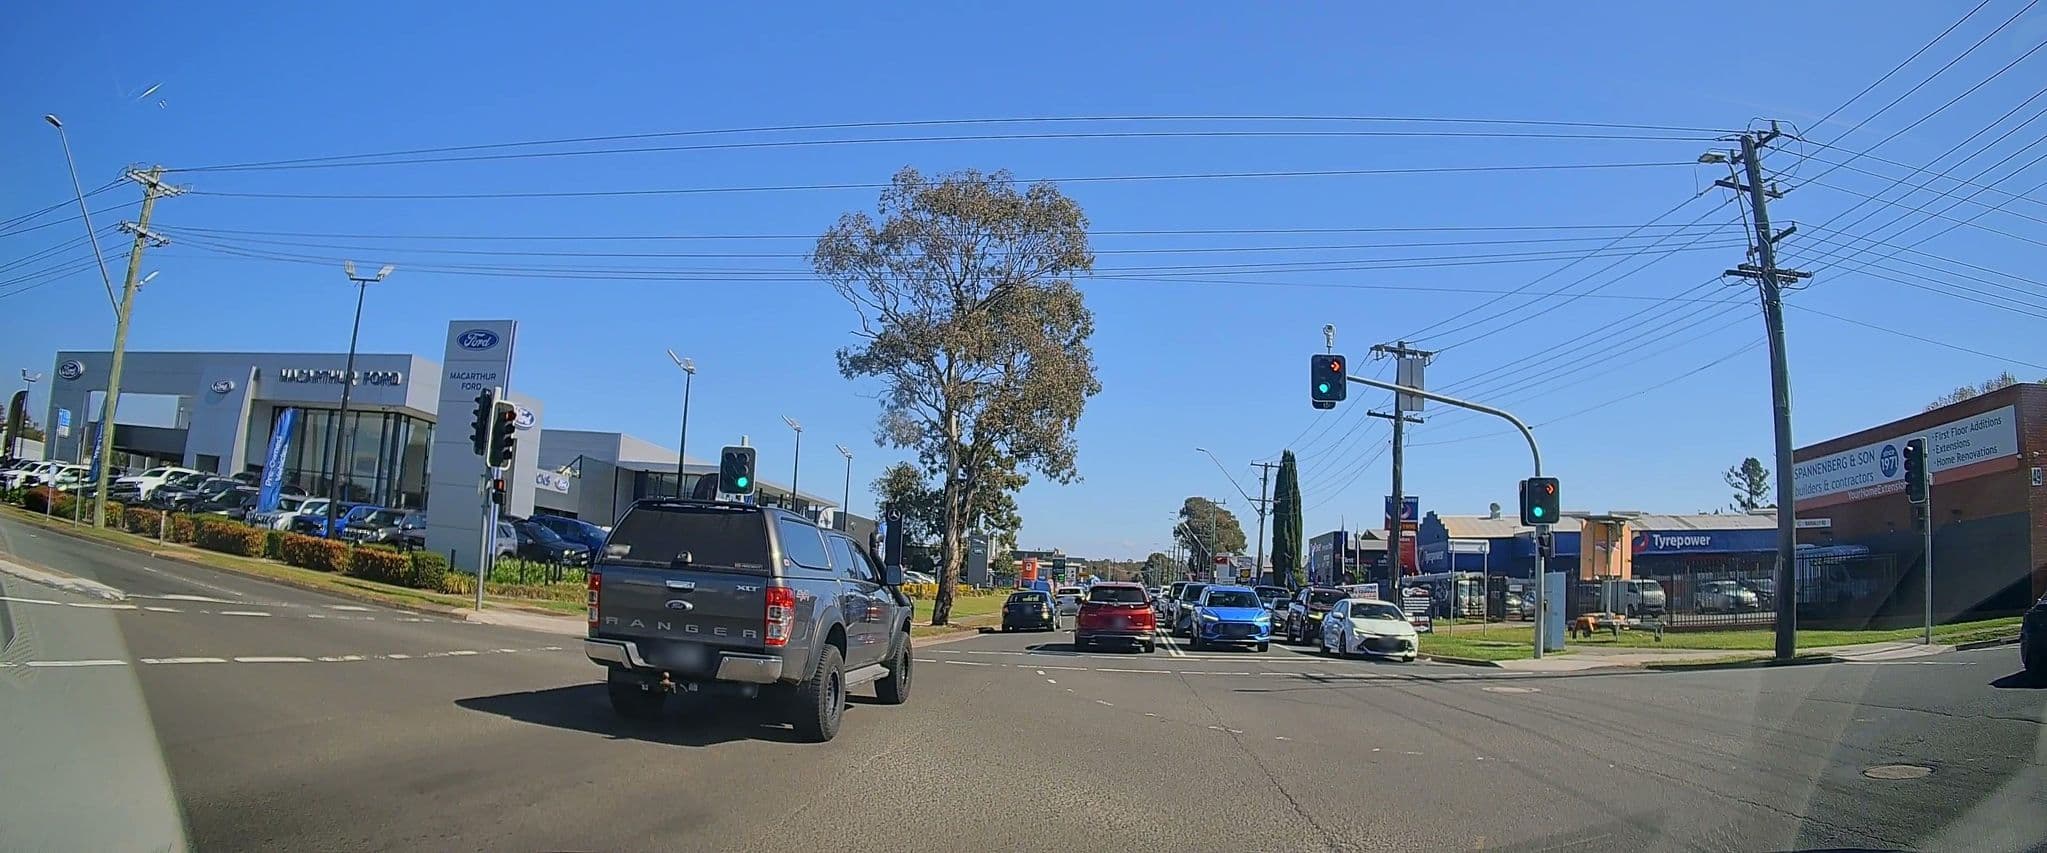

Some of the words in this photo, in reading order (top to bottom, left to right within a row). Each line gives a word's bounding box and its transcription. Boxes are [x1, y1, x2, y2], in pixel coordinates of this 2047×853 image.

[462, 332, 494, 348] Ford
[363, 370, 402, 386] FORD
[450, 372, 496, 381] MACARTHUR
[461, 382, 482, 391] FORD
[1935, 432, 1950, 441] First
[1951, 426, 1968, 437] Floor
[1970, 417, 2002, 432] Additions
[1936, 439, 1971, 454] Extensions
[1881, 456, 1899, 472] 1971
[1937, 455, 1956, 467] Home
[1957, 445, 1998, 462] Renovations
[1794, 456, 1848, 480] SPANNENBERG
[1850, 454, 1856, 467] &
[1858, 450, 1875, 465] SON
[1794, 481, 1822, 497] builders
[1832, 472, 1874, 489] contractors
[2033, 469, 2041, 485] 49
[1653, 533, 1712, 549] Tyrepower
[736, 584, 760, 592] XLT
[606, 616, 758, 639] RANGER
